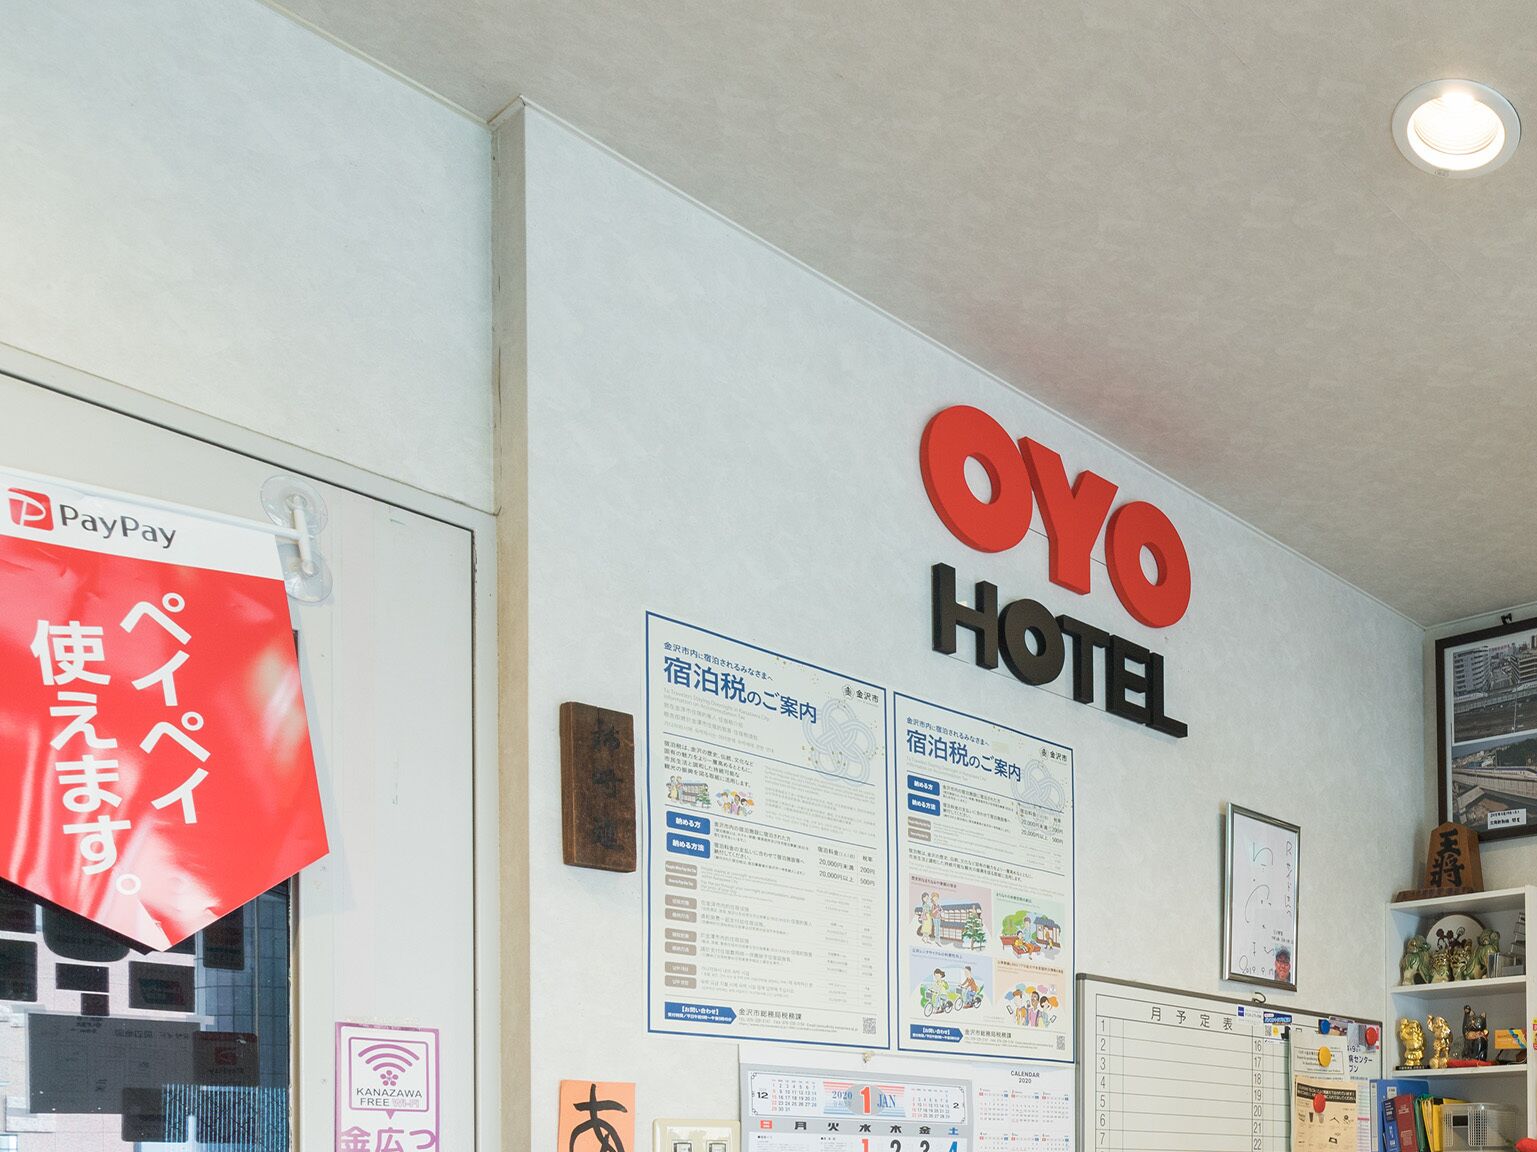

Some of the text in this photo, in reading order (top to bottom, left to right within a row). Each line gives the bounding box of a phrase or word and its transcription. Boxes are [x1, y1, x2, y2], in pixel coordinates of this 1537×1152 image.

[919, 405, 1191, 628] OYO
[59, 503, 176, 549] PayPay
[931, 562, 1188, 739] HOTEL
[664, 641, 773, 681] 金沢市内に宿泊されるみなさまへ
[664, 656, 817, 724] 宿泊税のご案内
[856, 689, 879, 703] 金沢市
[120, 592, 211, 824] ペイペイ
[30, 620, 142, 894] 使えます。
[907, 729, 1021, 782] 宿泊税のご案内
[675, 816, 702, 829] 納める方
[1430, 828, 1465, 888] 王将
[1100, 1019, 1105, 1031] 1
[1151, 1006, 1233, 1031] 月予定表
[1099, 1038, 1106, 1051] 2
[1253, 1040, 1262, 1052] 16
[1099, 1057, 1106, 1070] 3
[1253, 1055, 1262, 1069] 17
[1010, 1070, 1040, 1078] CALENDAR
[1253, 1072, 1262, 1086] 18
[1099, 1076, 1106, 1088] 4
[356, 1087, 422, 1099] KANAZAWA
[757, 1091, 769, 1099] 12
[831, 1091, 853, 1100] 2020
[860, 1086, 871, 1114] 1
[1253, 1088, 1262, 1102] 19
[360, 1098, 389, 1107] FREE
[877, 1094, 897, 1108] JAN
[1099, 1095, 1106, 1108] 5
[1253, 1105, 1262, 1117] 20
[1099, 1113, 1106, 1127] 6
[760, 1120, 958, 1135] 日 月 火 水 木 金 土
[1253, 1121, 1262, 1135] 21
[1099, 1132, 1106, 1144] 7
[1253, 1138, 1262, 1150] 22
